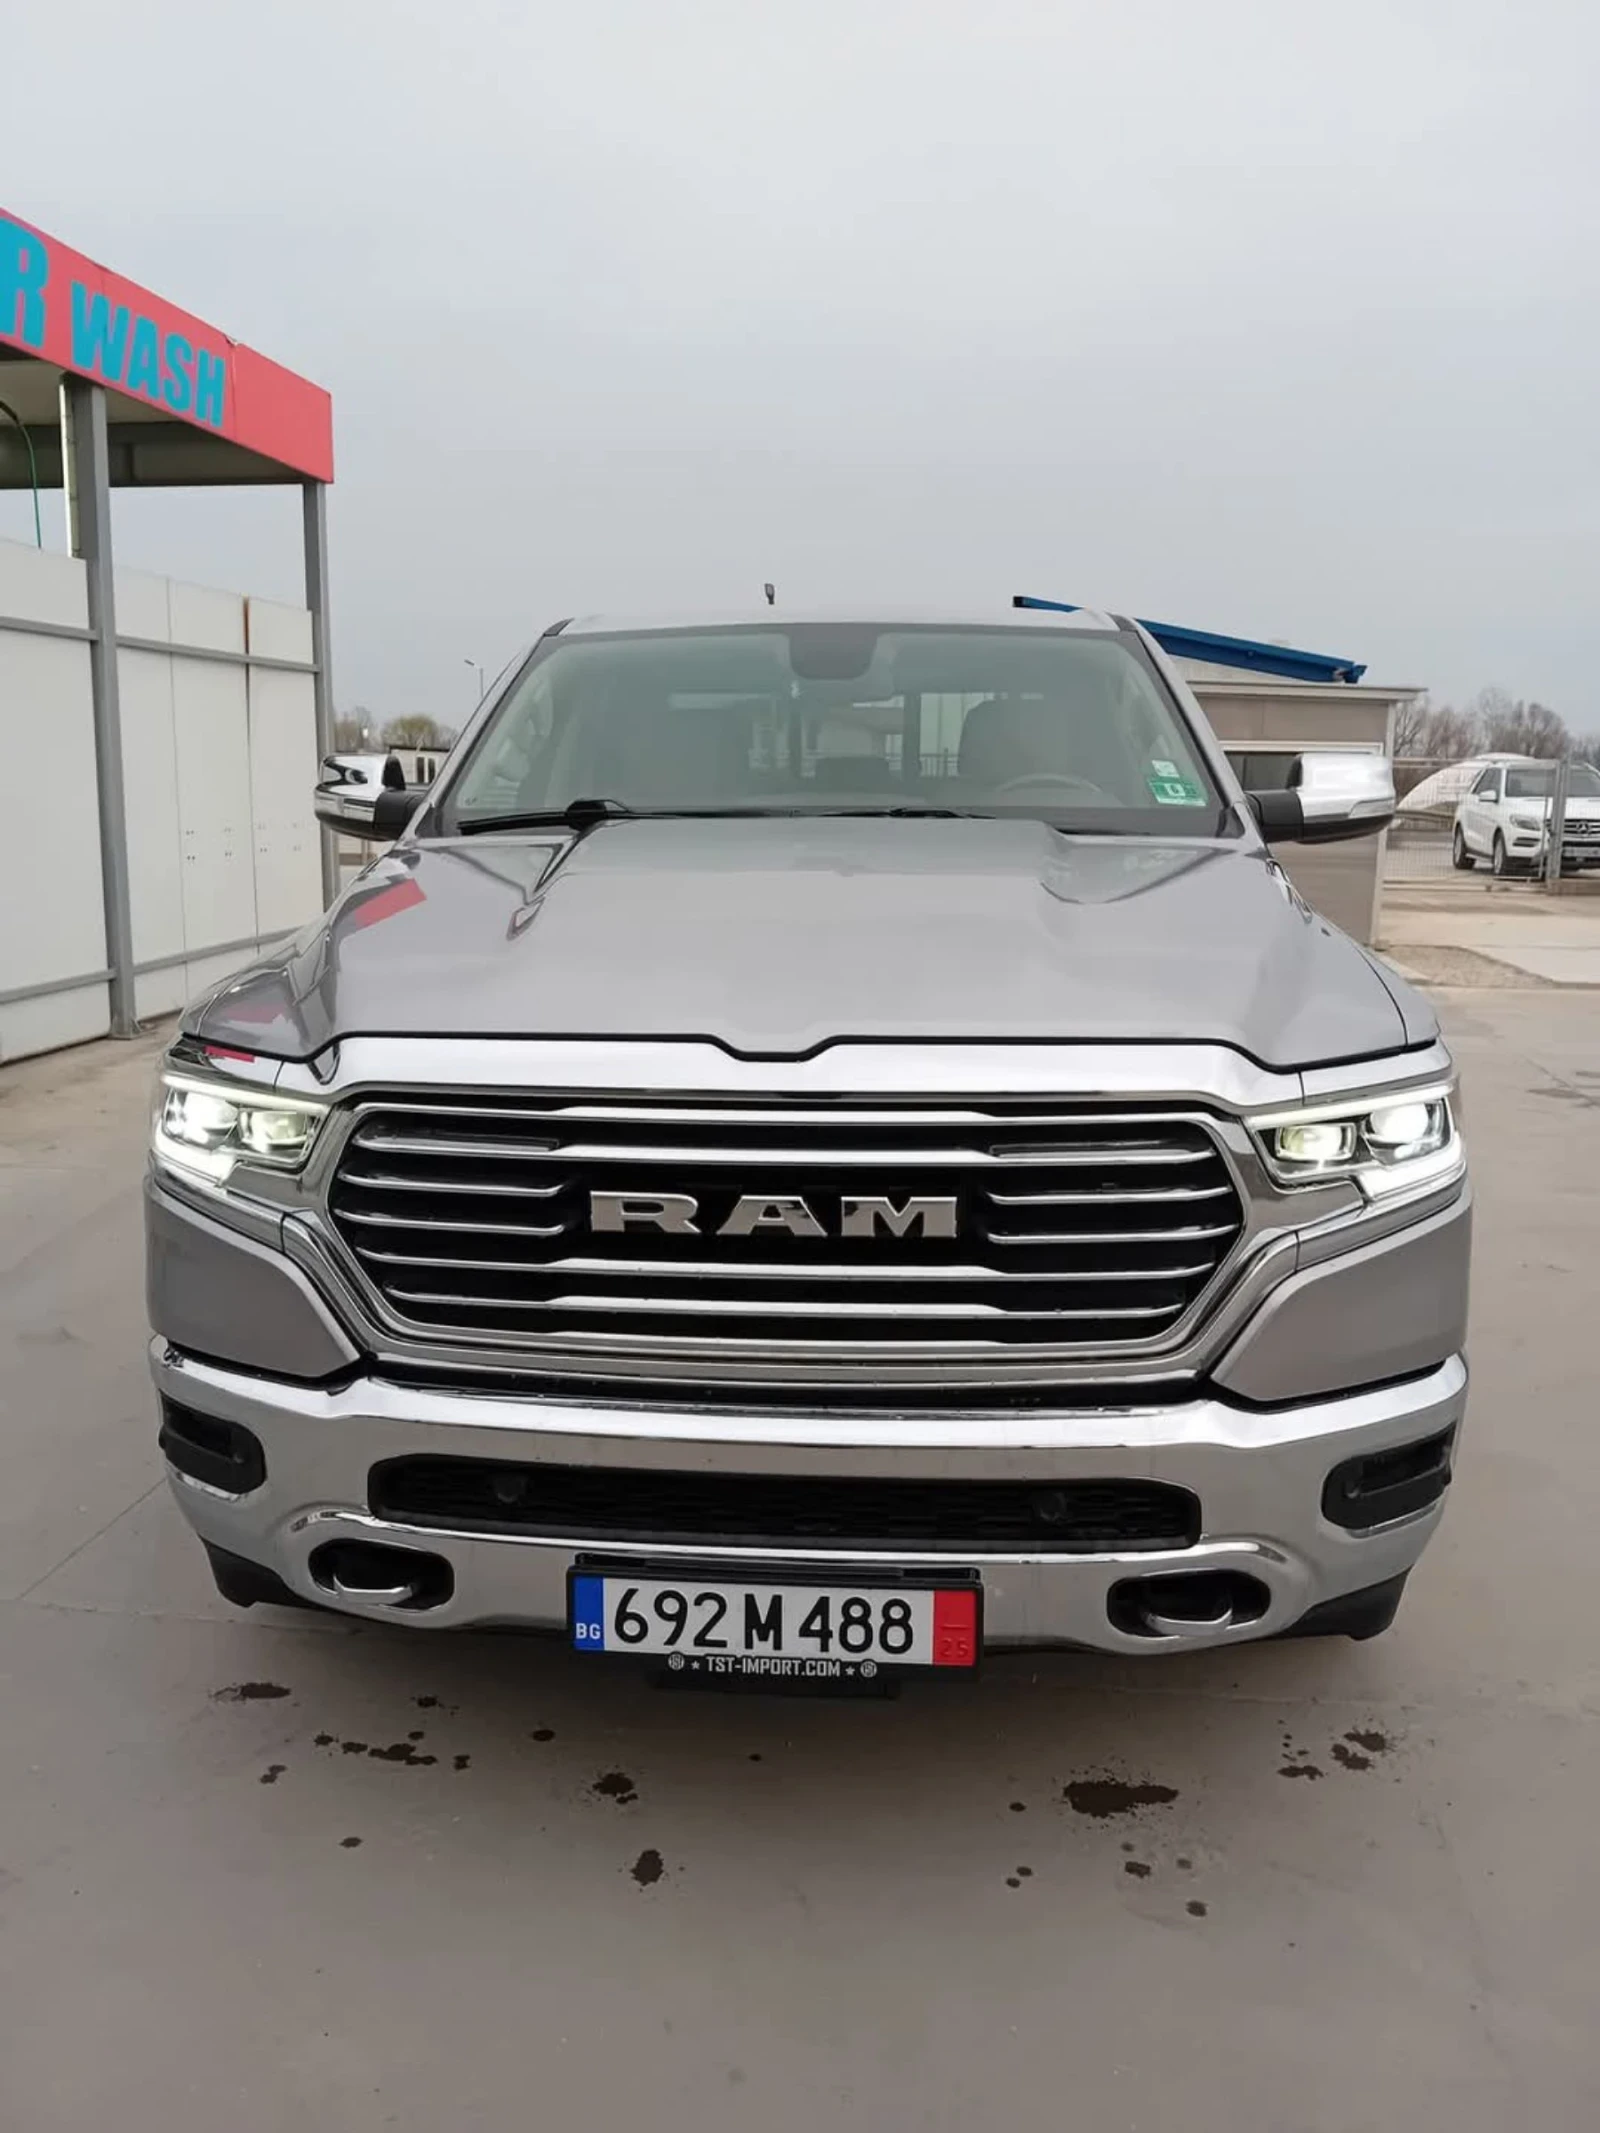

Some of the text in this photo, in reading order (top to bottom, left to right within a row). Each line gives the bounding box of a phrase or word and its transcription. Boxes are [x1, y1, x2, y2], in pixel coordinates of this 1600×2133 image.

[70, 280, 227, 428] WASH
[589, 1190, 958, 1238] RAM
[575, 1622, 602, 1641] BG
[613, 1588, 914, 1655] 692 M 488
[705, 1655, 841, 1677] TST-IMPORT.COM
